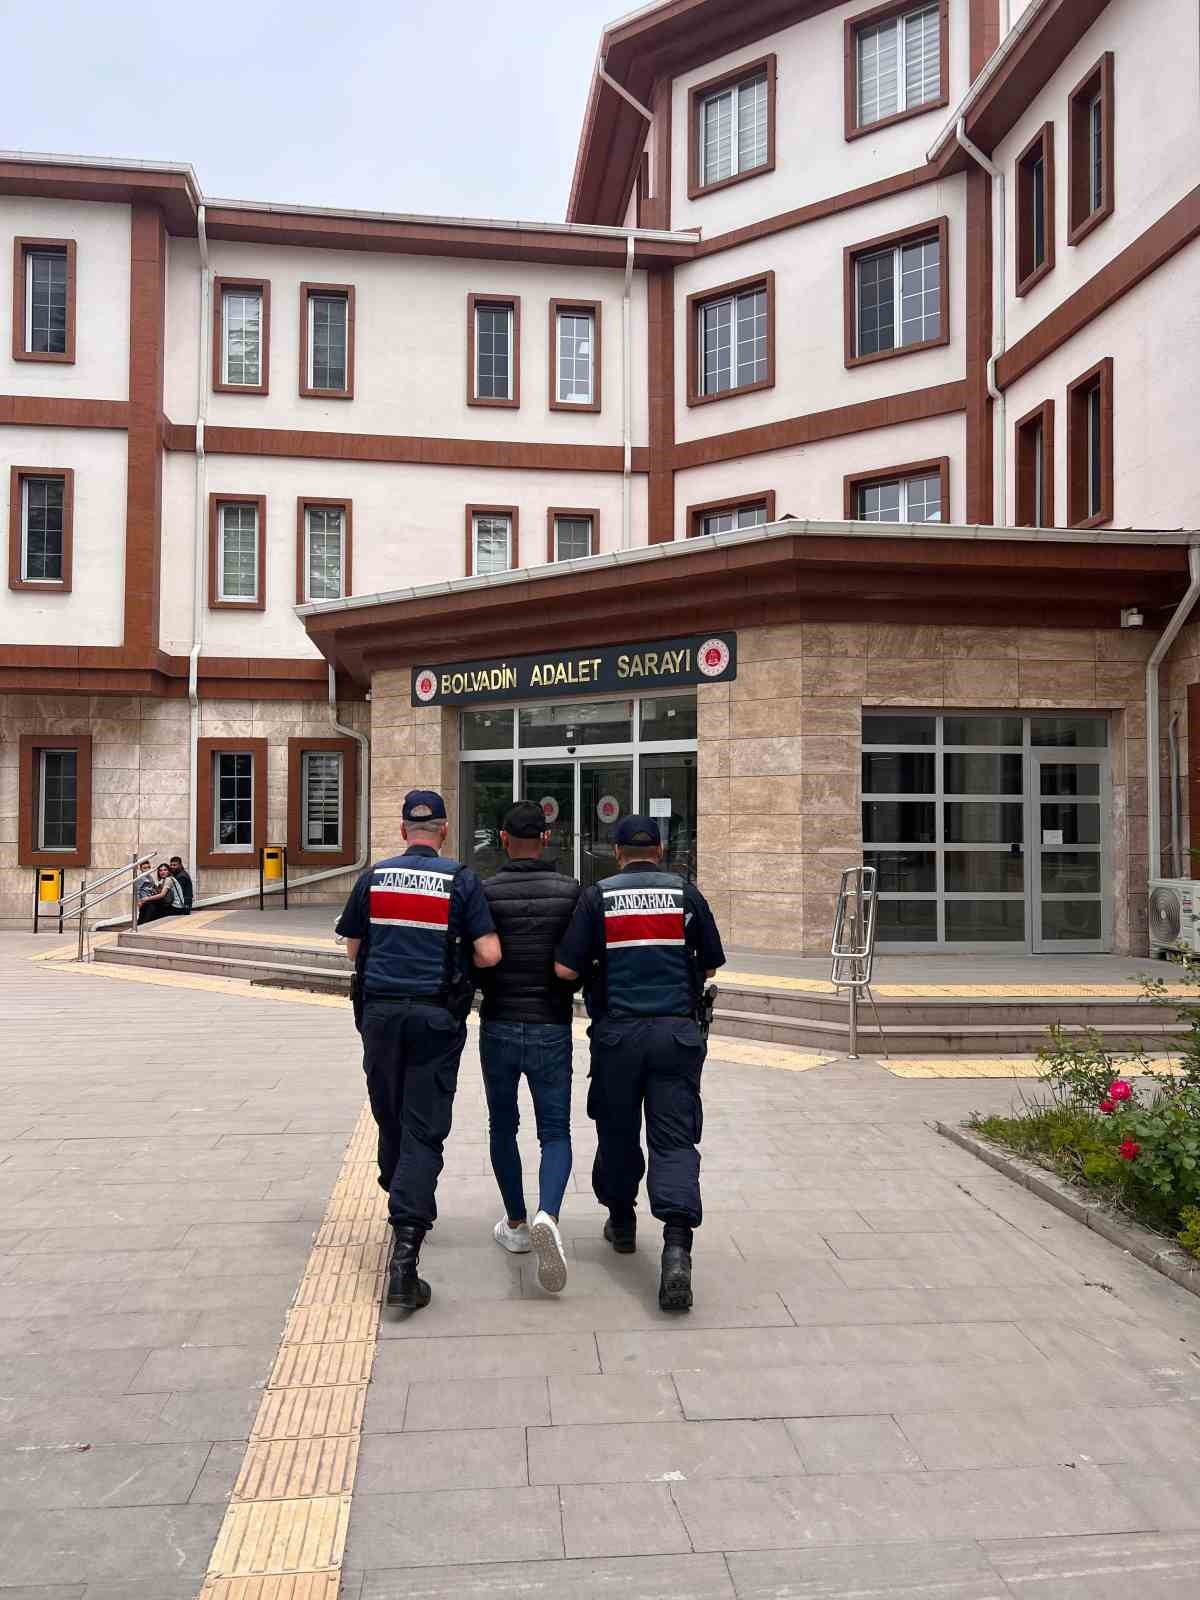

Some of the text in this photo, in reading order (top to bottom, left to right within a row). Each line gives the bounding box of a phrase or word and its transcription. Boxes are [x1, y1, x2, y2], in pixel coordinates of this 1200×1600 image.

[441, 649, 690, 695] BOLVADİN ADALET SARAYI
[379, 872, 445, 892] JANDARMA
[611, 894, 676, 911] JANDARMA
